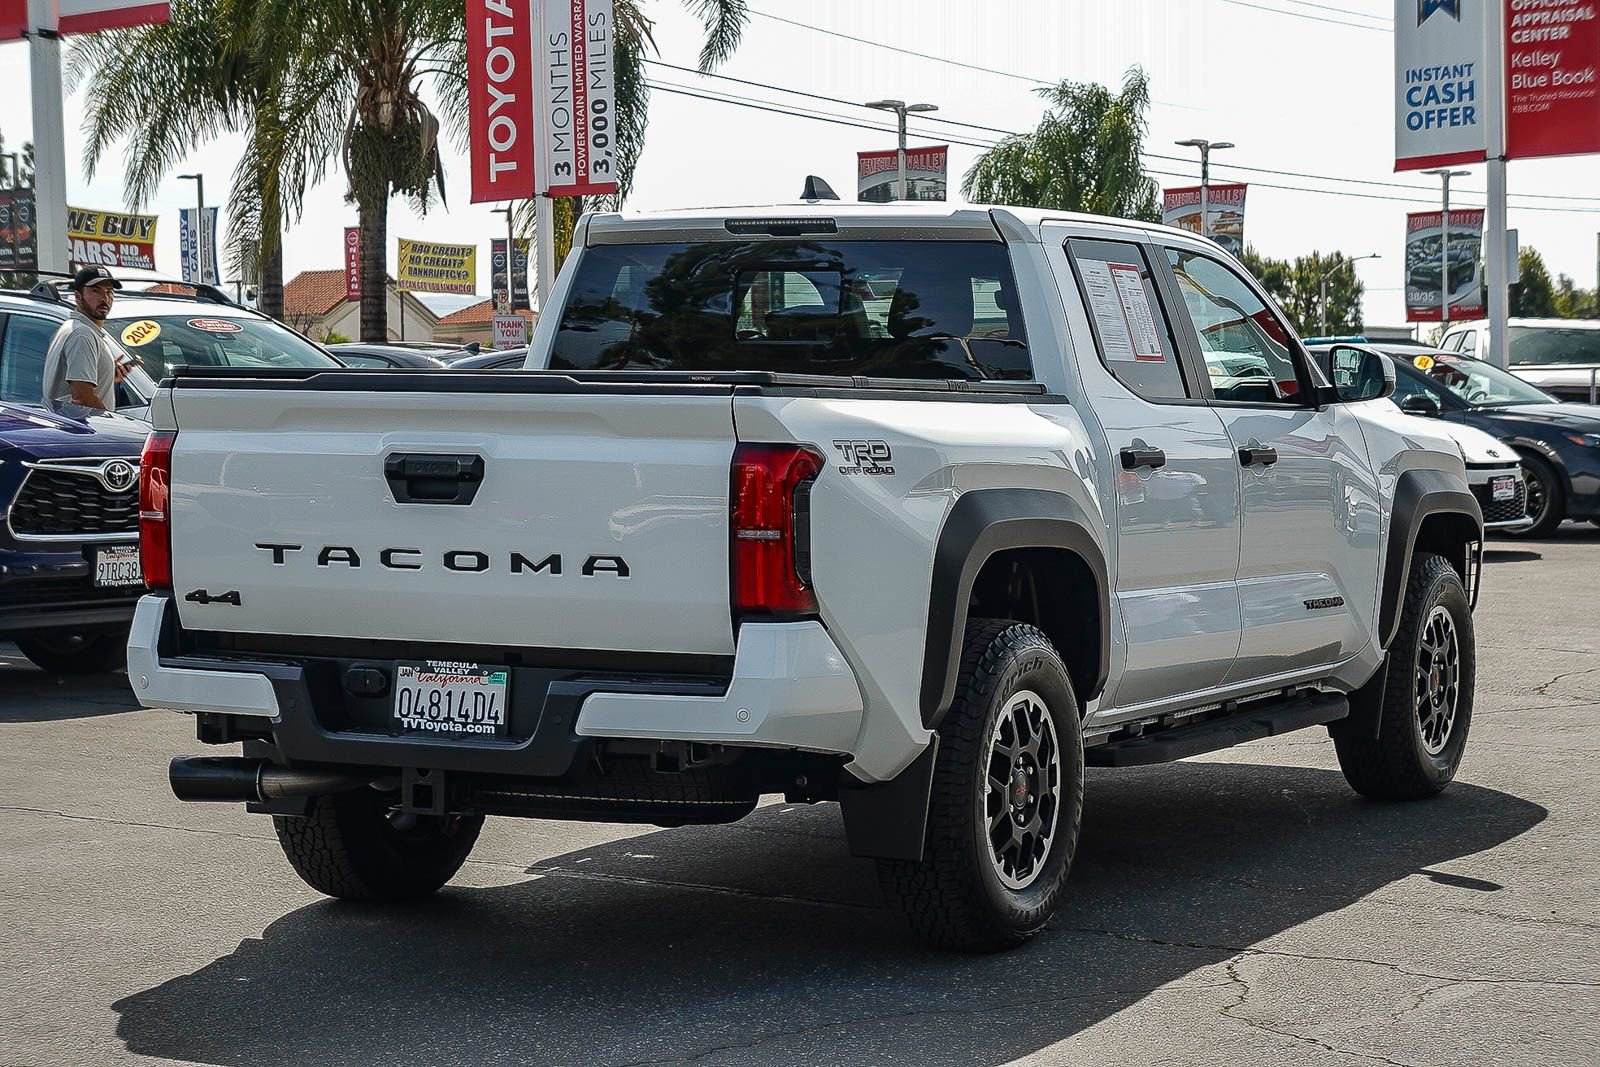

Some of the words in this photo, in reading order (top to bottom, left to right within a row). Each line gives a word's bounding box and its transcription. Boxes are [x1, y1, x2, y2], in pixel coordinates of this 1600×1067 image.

[1511, 6, 1596, 28] APPRAISAL
[1511, 26, 1570, 44] CENTER
[588, 12, 607, 90] MILES
[1511, 51, 1560, 69] Kelley
[575, 45, 584, 93] LIMITED
[1405, 63, 1474, 83] INSTANT
[1512, 73, 1548, 90] Blue
[1552, 67, 1595, 86] Book
[485, 0, 518, 183] TOYOTA
[550, 32, 570, 153] MONTHS
[1406, 80, 1476, 107] CASH
[1512, 95, 1527, 103] The
[1529, 92, 1557, 102] Trusted
[1406, 106, 1476, 131] OFFER
[577, 95, 586, 177] POWERTRAIN
[591, 98, 612, 174] 3,000
[554, 161, 571, 176] 3
[860, 156, 898, 176] TEMECULA
[907, 152, 946, 175] VALLEY
[1209, 188, 1246, 208] VALLEY
[101, 215, 153, 240] BUY
[180, 217, 188, 251] BUY
[120, 244, 139, 256] NO
[190, 229, 198, 272] CARS
[411, 243, 430, 254] BAD
[432, 245, 473, 257] CREDIT?
[182, 256, 190, 281] WE
[349, 247, 359, 290] NISSAN
[408, 255, 421, 265] NO
[423, 256, 465, 269] CREDIT?
[407, 267, 470, 280] BANKRUPTCY?
[126, 322, 156, 344] 2024
[496, 320, 524, 329] THANK
[500, 328, 520, 337] YOU!
[832, 439, 892, 468] TRD
[838, 466, 862, 475] OFF
[862, 466, 896, 475] ROAD
[98, 561, 139, 580] 9TRC38
[254, 542, 631, 578] TACOMA
[101, 578, 143, 587] TVToyota.com
[1303, 595, 1345, 610] TACOMA
[426, 659, 478, 670] TEMECULA
[433, 667, 470, 675] VALLEY
[400, 667, 414, 678] JAN
[417, 672, 481, 689] California
[398, 687, 501, 723] 04814D4
[401, 717, 495, 734] TVToyota.com
